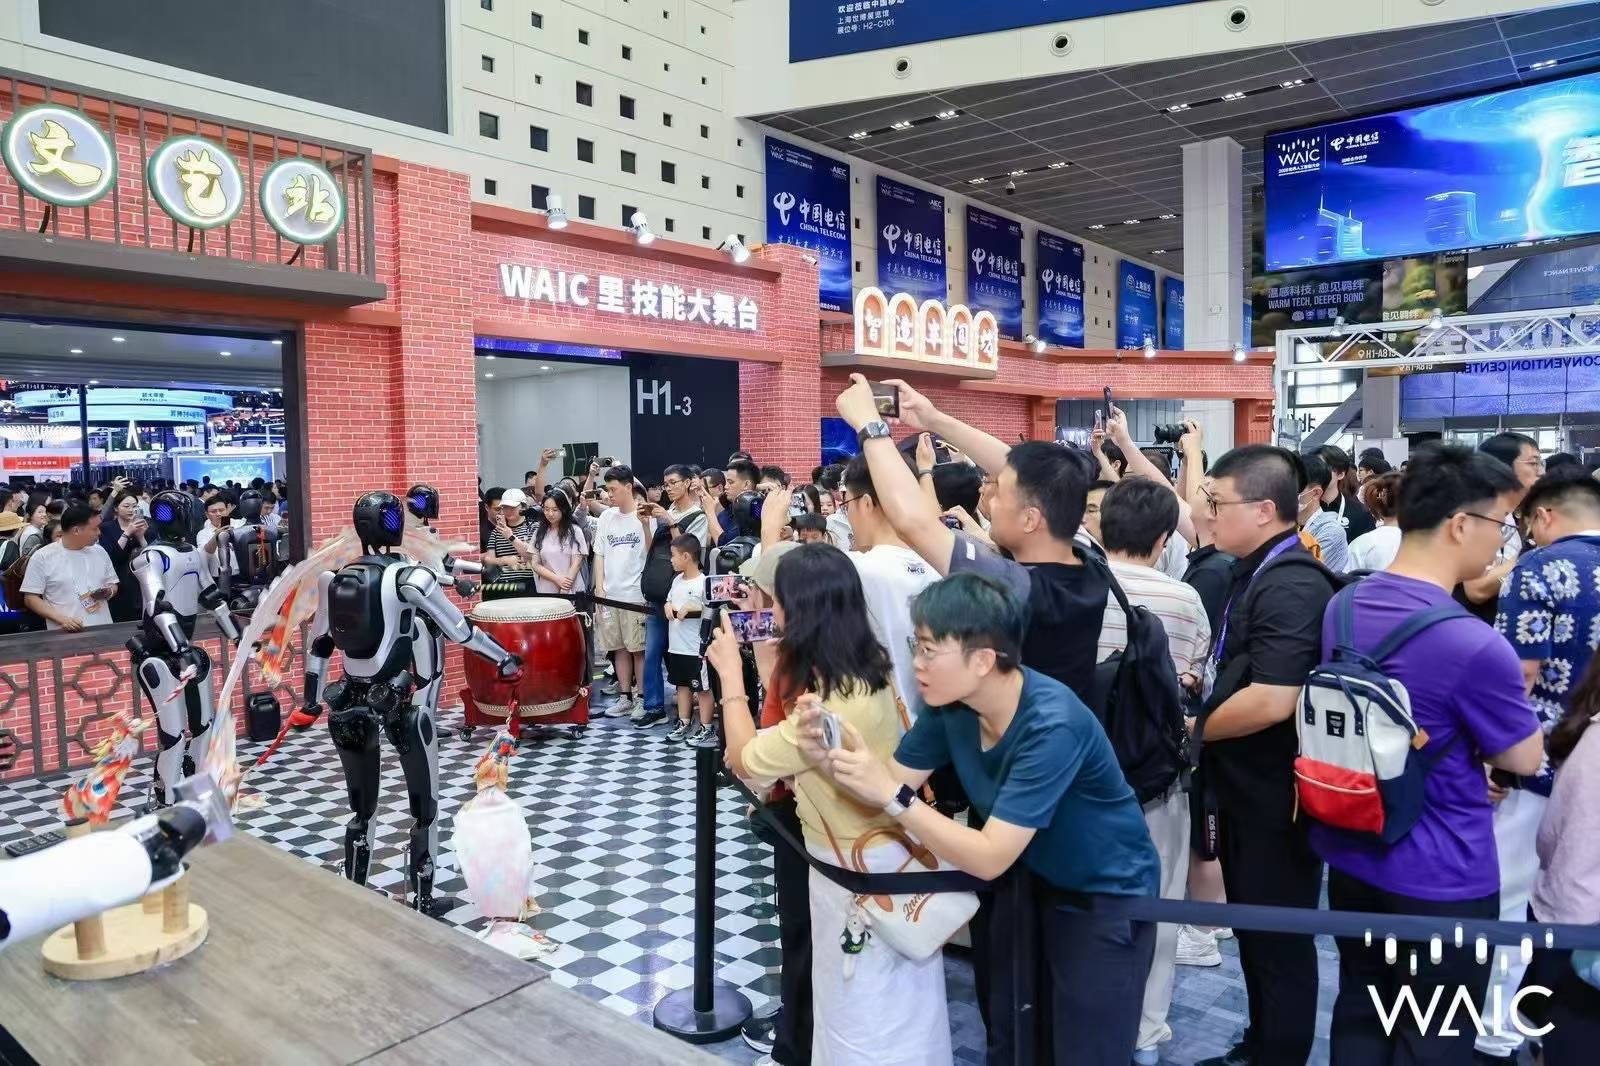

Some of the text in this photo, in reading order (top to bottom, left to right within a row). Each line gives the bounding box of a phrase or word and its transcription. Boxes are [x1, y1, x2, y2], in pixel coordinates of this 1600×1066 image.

[1278, 149, 1320, 167] WAIC
[799, 197, 846, 232] 中国电信
[799, 222, 847, 241] CHINA TELECOM
[903, 229, 942, 257] 中国电信
[903, 250, 942, 265] CHINA TELECOM
[987, 251, 1019, 278] 中国电信
[499, 263, 760, 331] WAIC 里 技能大舞台
[1055, 271, 1081, 297] 中国电信
[1268, 292, 1365, 310] WARM TECH, DEEPER BOND
[636, 378, 692, 417] H1-3
[1207, 814, 1216, 831] EOS
